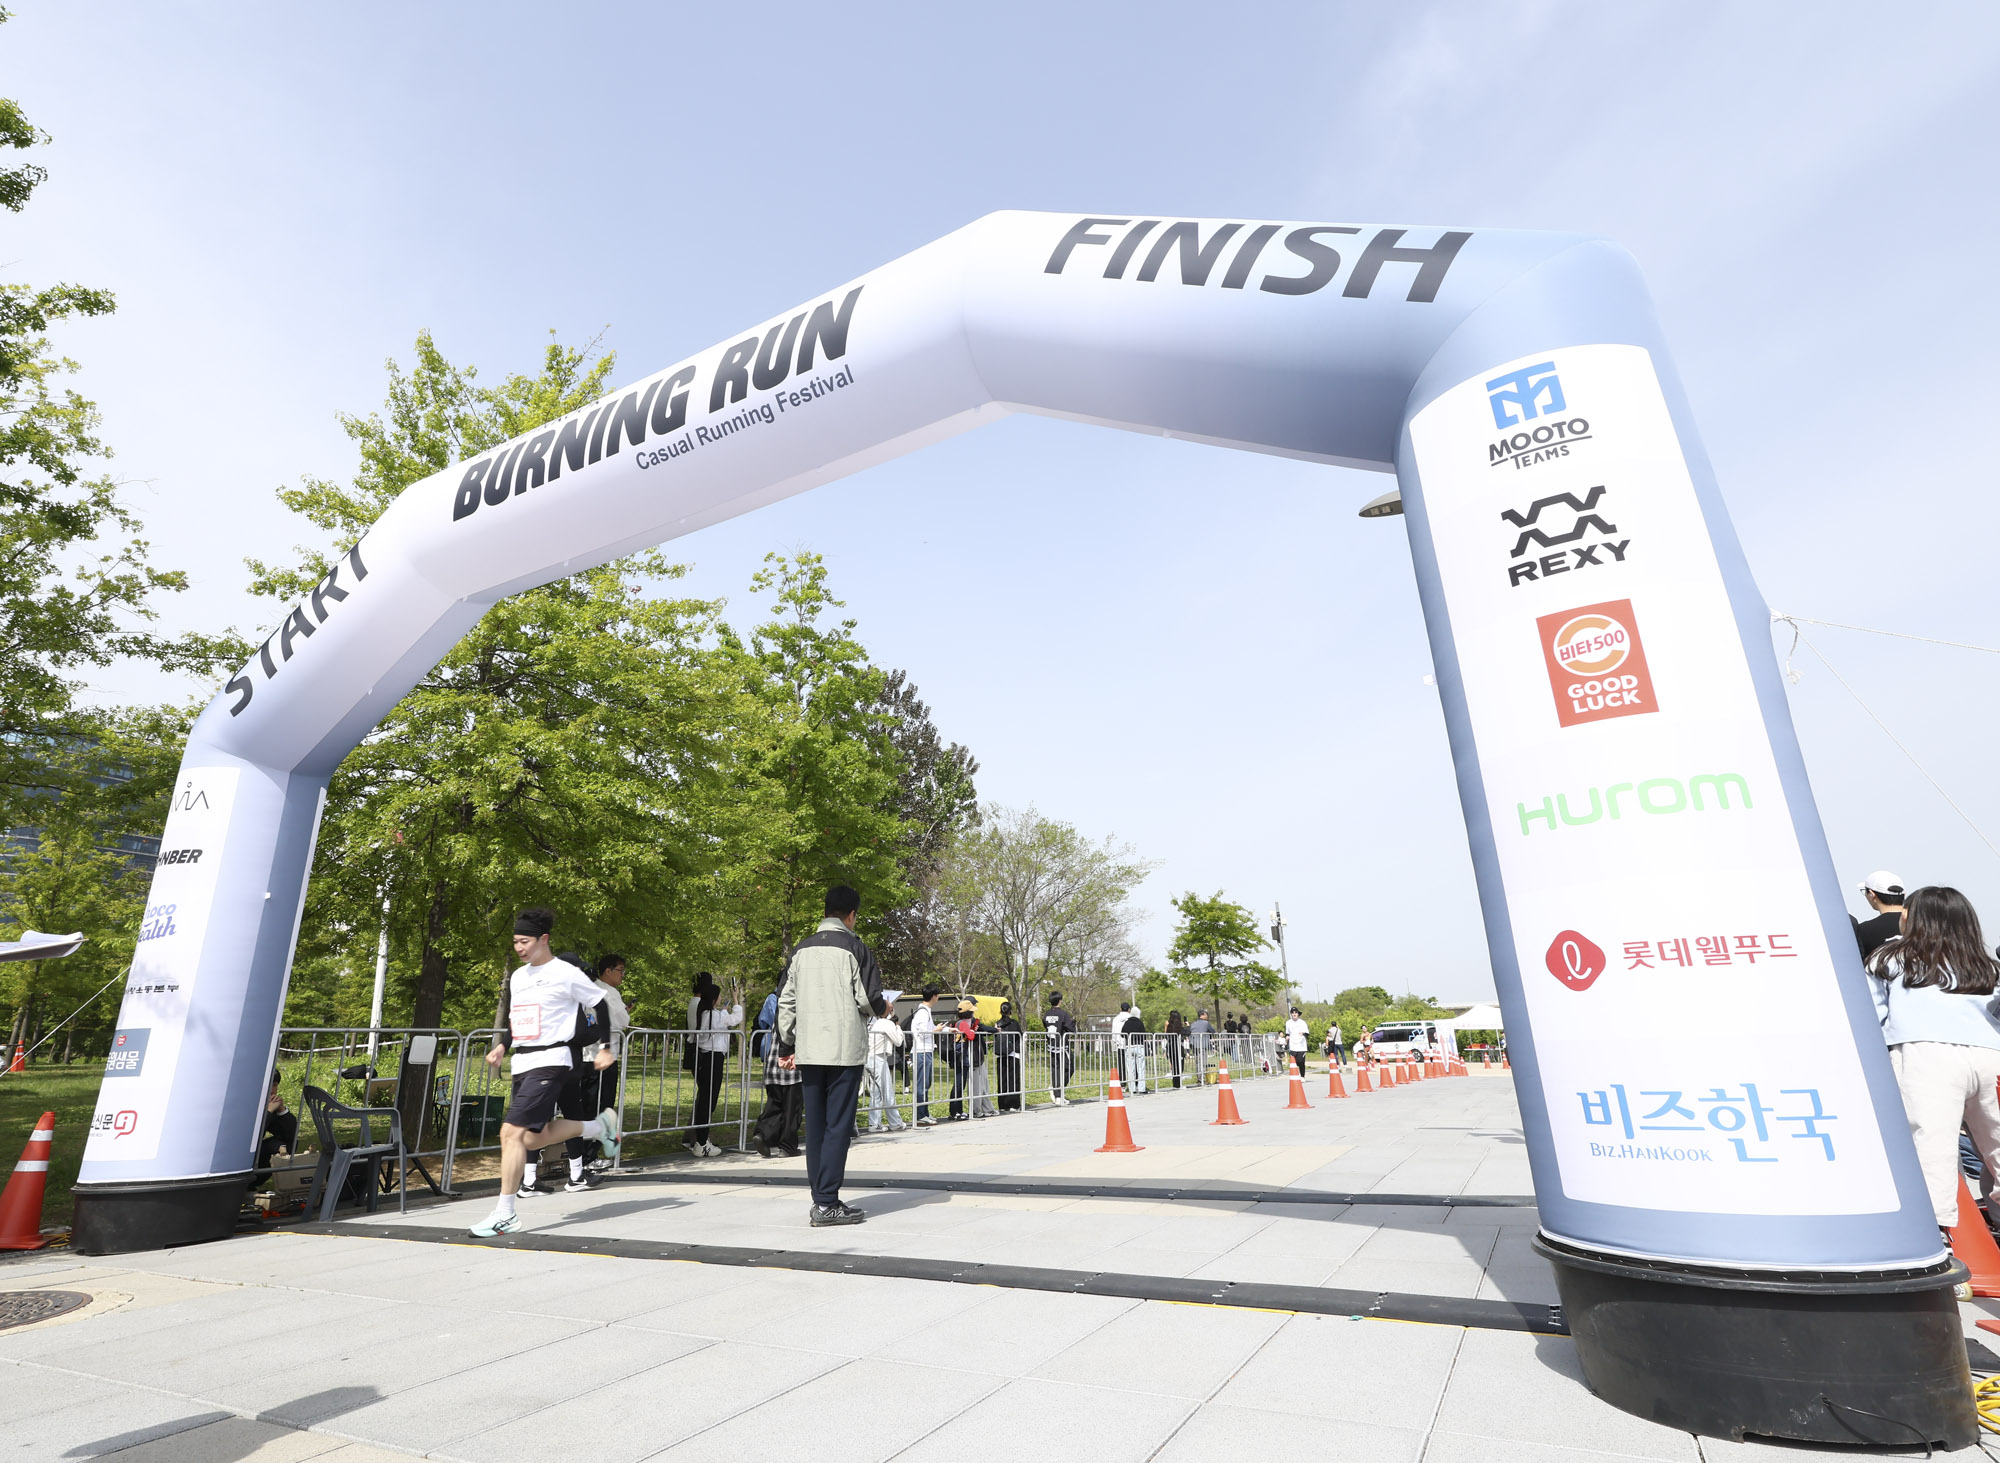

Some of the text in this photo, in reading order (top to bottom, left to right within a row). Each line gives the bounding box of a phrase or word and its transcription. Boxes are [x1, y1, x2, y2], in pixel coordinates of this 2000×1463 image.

[1044, 218, 1475, 303] FINISH
[453, 284, 866, 522] BURNING RUN
[635, 364, 855, 471] Casual Running Festival
[1489, 418, 1591, 462] MOOTO
[1510, 445, 1570, 470] TEAMS
[1507, 539, 1632, 587] REXY
[225, 530, 369, 718] START
[1559, 629, 1625, 662] 비타500
[1567, 675, 1639, 699] GOOD
[1572, 689, 1642, 714] LUCK
[1622, 934, 1798, 970] 롯데웰푸드
[1576, 1083, 1838, 1162] 비즈한국
